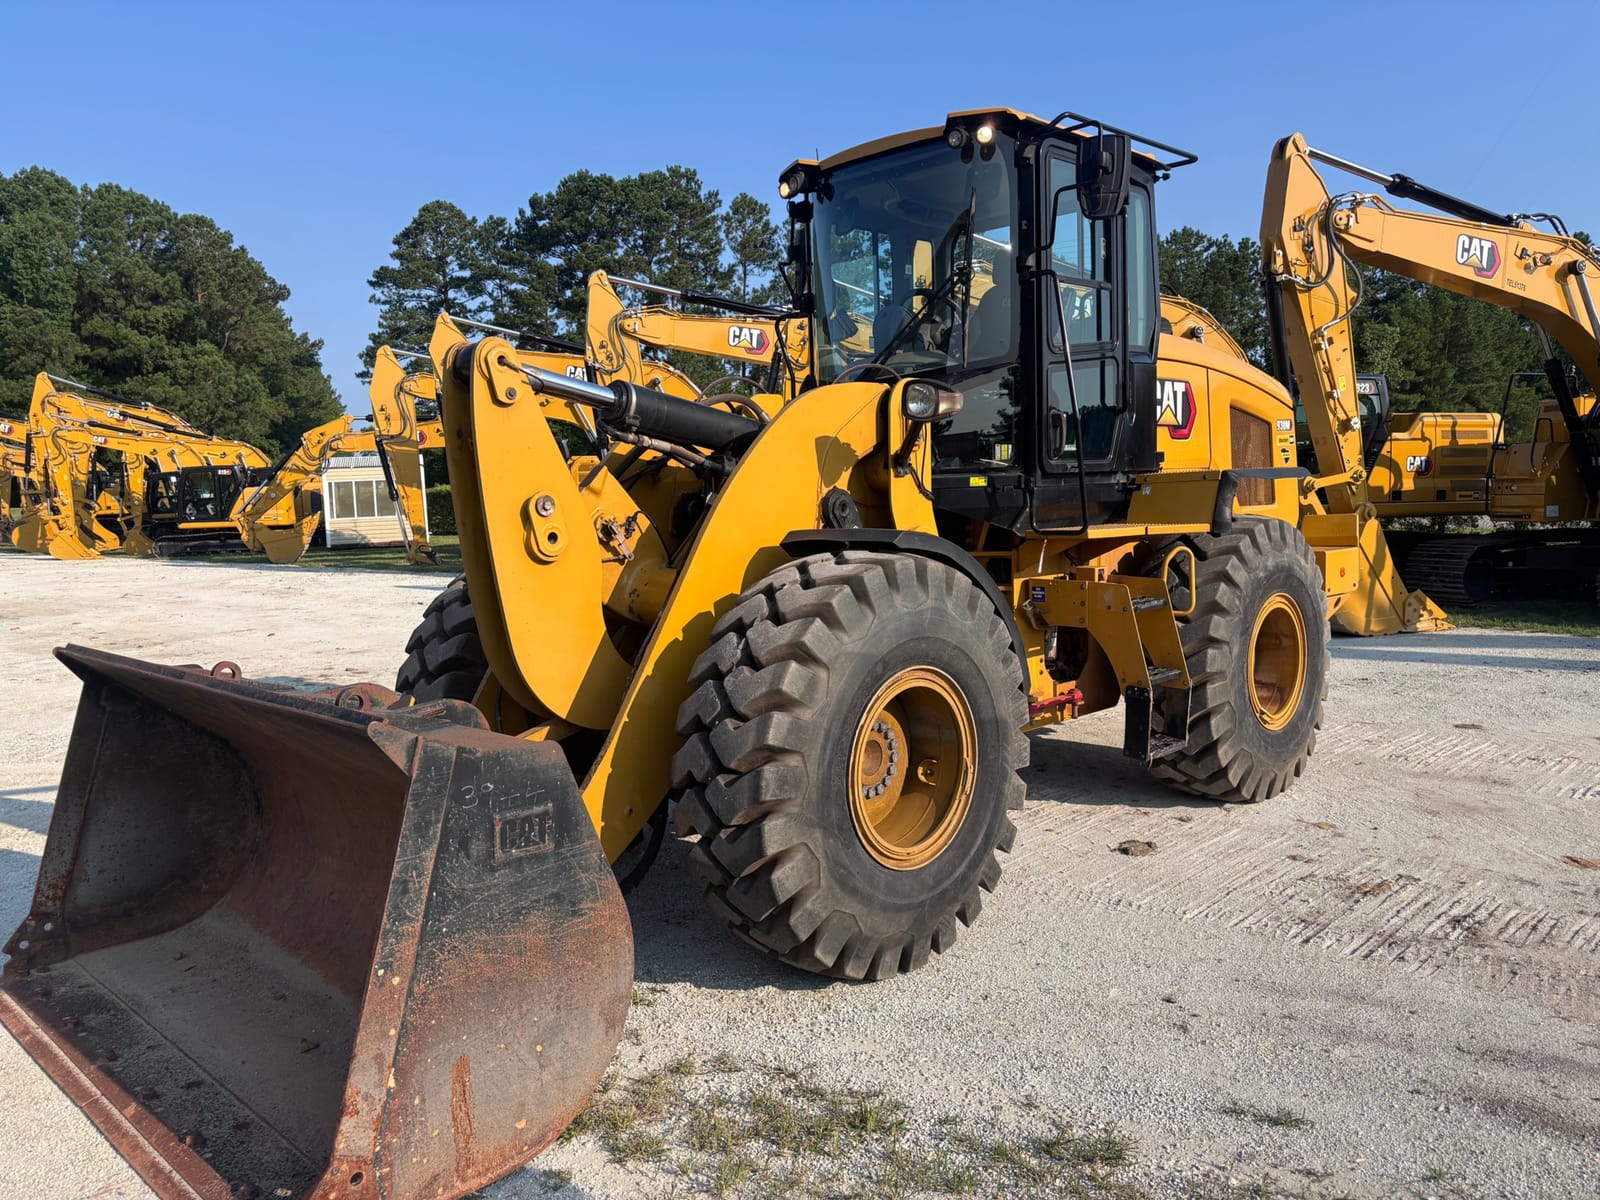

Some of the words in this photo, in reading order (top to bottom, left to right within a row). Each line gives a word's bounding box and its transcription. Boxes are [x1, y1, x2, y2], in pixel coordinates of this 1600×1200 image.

[1457, 234, 1492, 270] CAT
[729, 326, 760, 349] CAT
[93, 435, 105, 444] CAT
[1406, 456, 1428, 472] CAT
